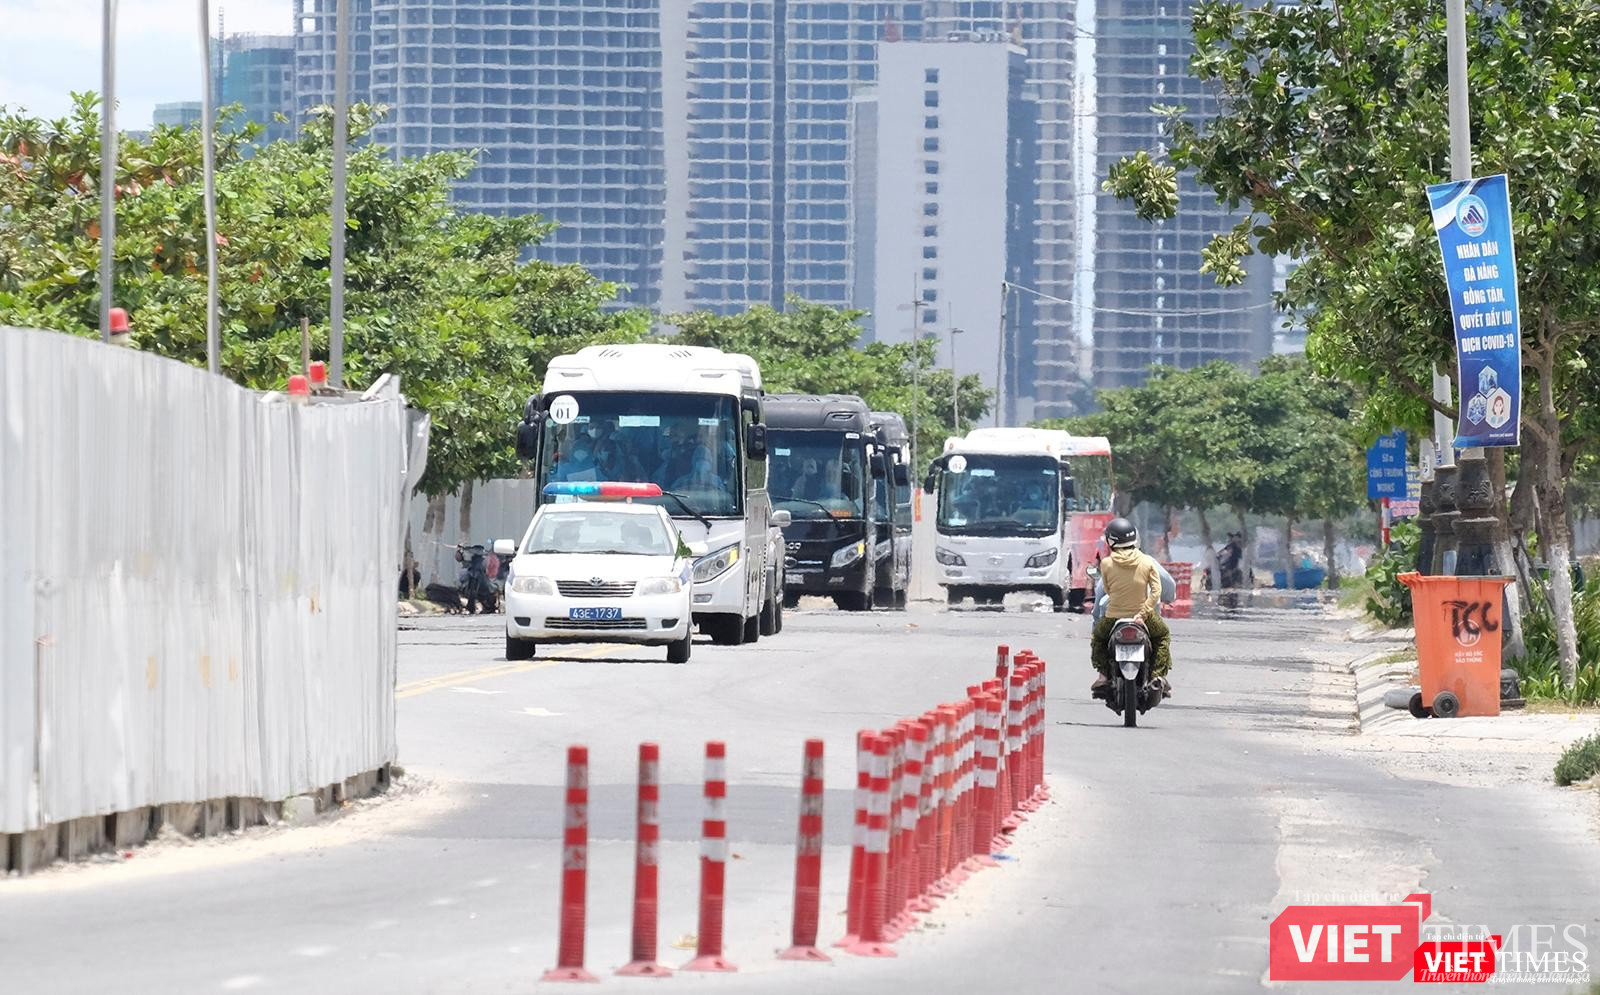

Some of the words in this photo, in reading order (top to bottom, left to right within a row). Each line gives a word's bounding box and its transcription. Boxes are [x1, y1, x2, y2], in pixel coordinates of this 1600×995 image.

[1456, 241, 1481, 259] NHÂN
[1481, 240, 1499, 257] DÂN
[1463, 265, 1476, 282] ĐÀ
[1463, 286, 1486, 305] ĐỒNG
[1486, 286, 1505, 303] TÂM,
[1460, 309, 1483, 330] QUYẾT
[1485, 307, 1501, 327] ĐẨY
[1461, 336, 1481, 355] DỊCH
[1482, 333, 1515, 350] COVID-19
[556, 407, 570, 419] 01
[572, 608, 619, 619] 43E-1737
